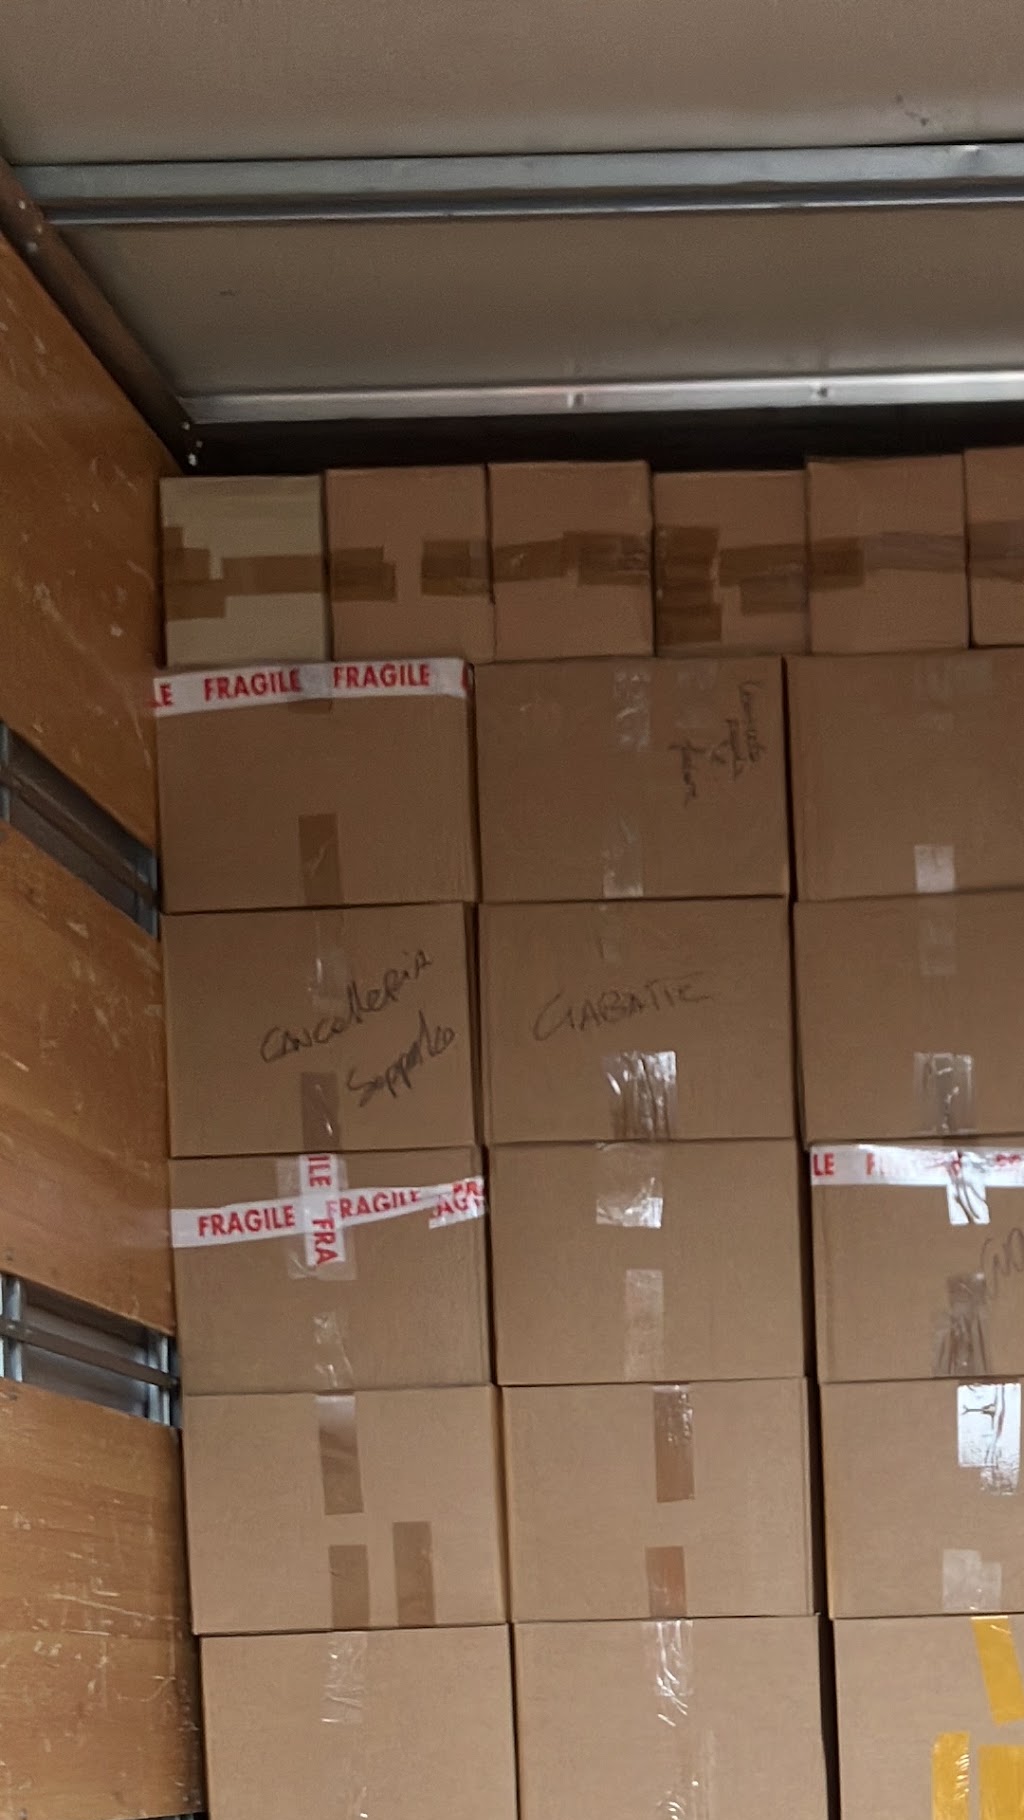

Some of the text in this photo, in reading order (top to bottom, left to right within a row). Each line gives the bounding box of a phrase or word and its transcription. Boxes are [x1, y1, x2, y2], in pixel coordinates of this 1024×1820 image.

[203, 669, 304, 701] FRAGILE
[332, 663, 430, 688] FRAGILE
[198, 1206, 296, 1237] FRAGILE
